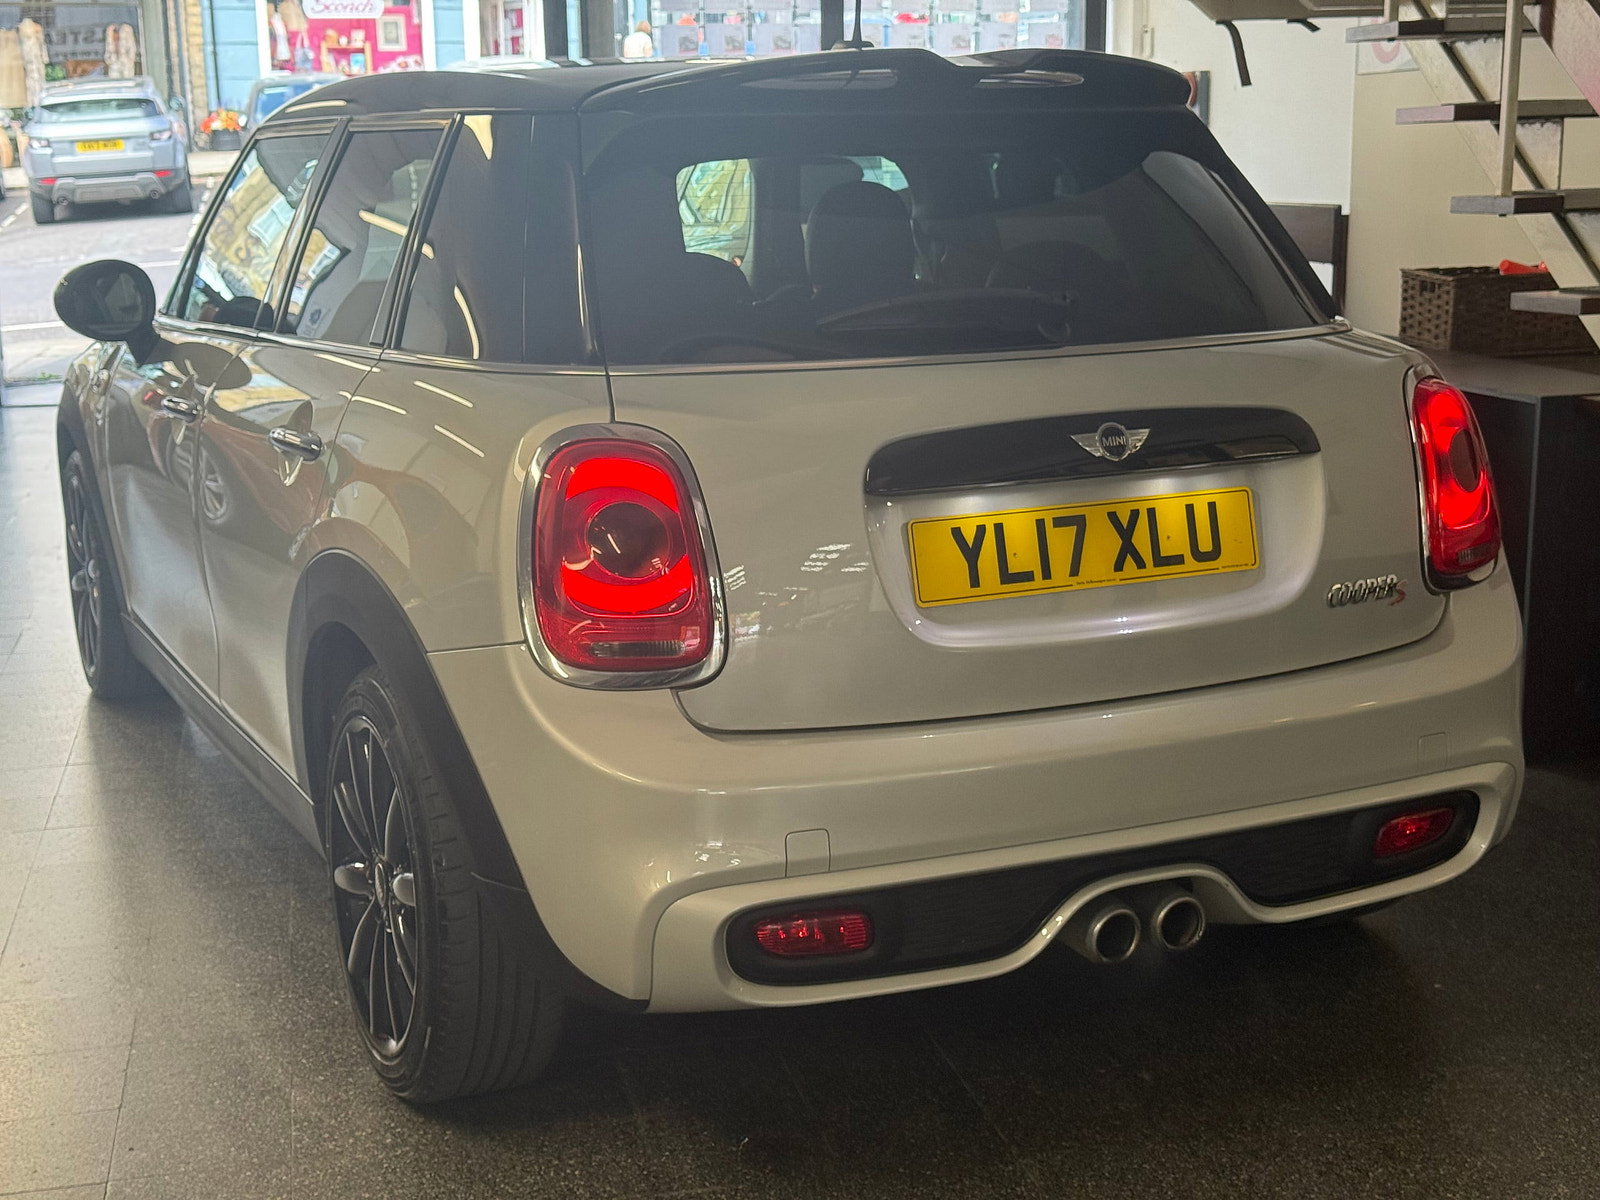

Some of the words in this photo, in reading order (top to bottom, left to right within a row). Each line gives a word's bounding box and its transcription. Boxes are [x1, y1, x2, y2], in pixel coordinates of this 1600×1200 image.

[1102, 435, 1127, 447] MINI
[951, 514, 1087, 588] YL17
[1107, 502, 1222, 573] XLU
[1327, 574, 1398, 608] COOPER
[1387, 580, 1408, 606] S
